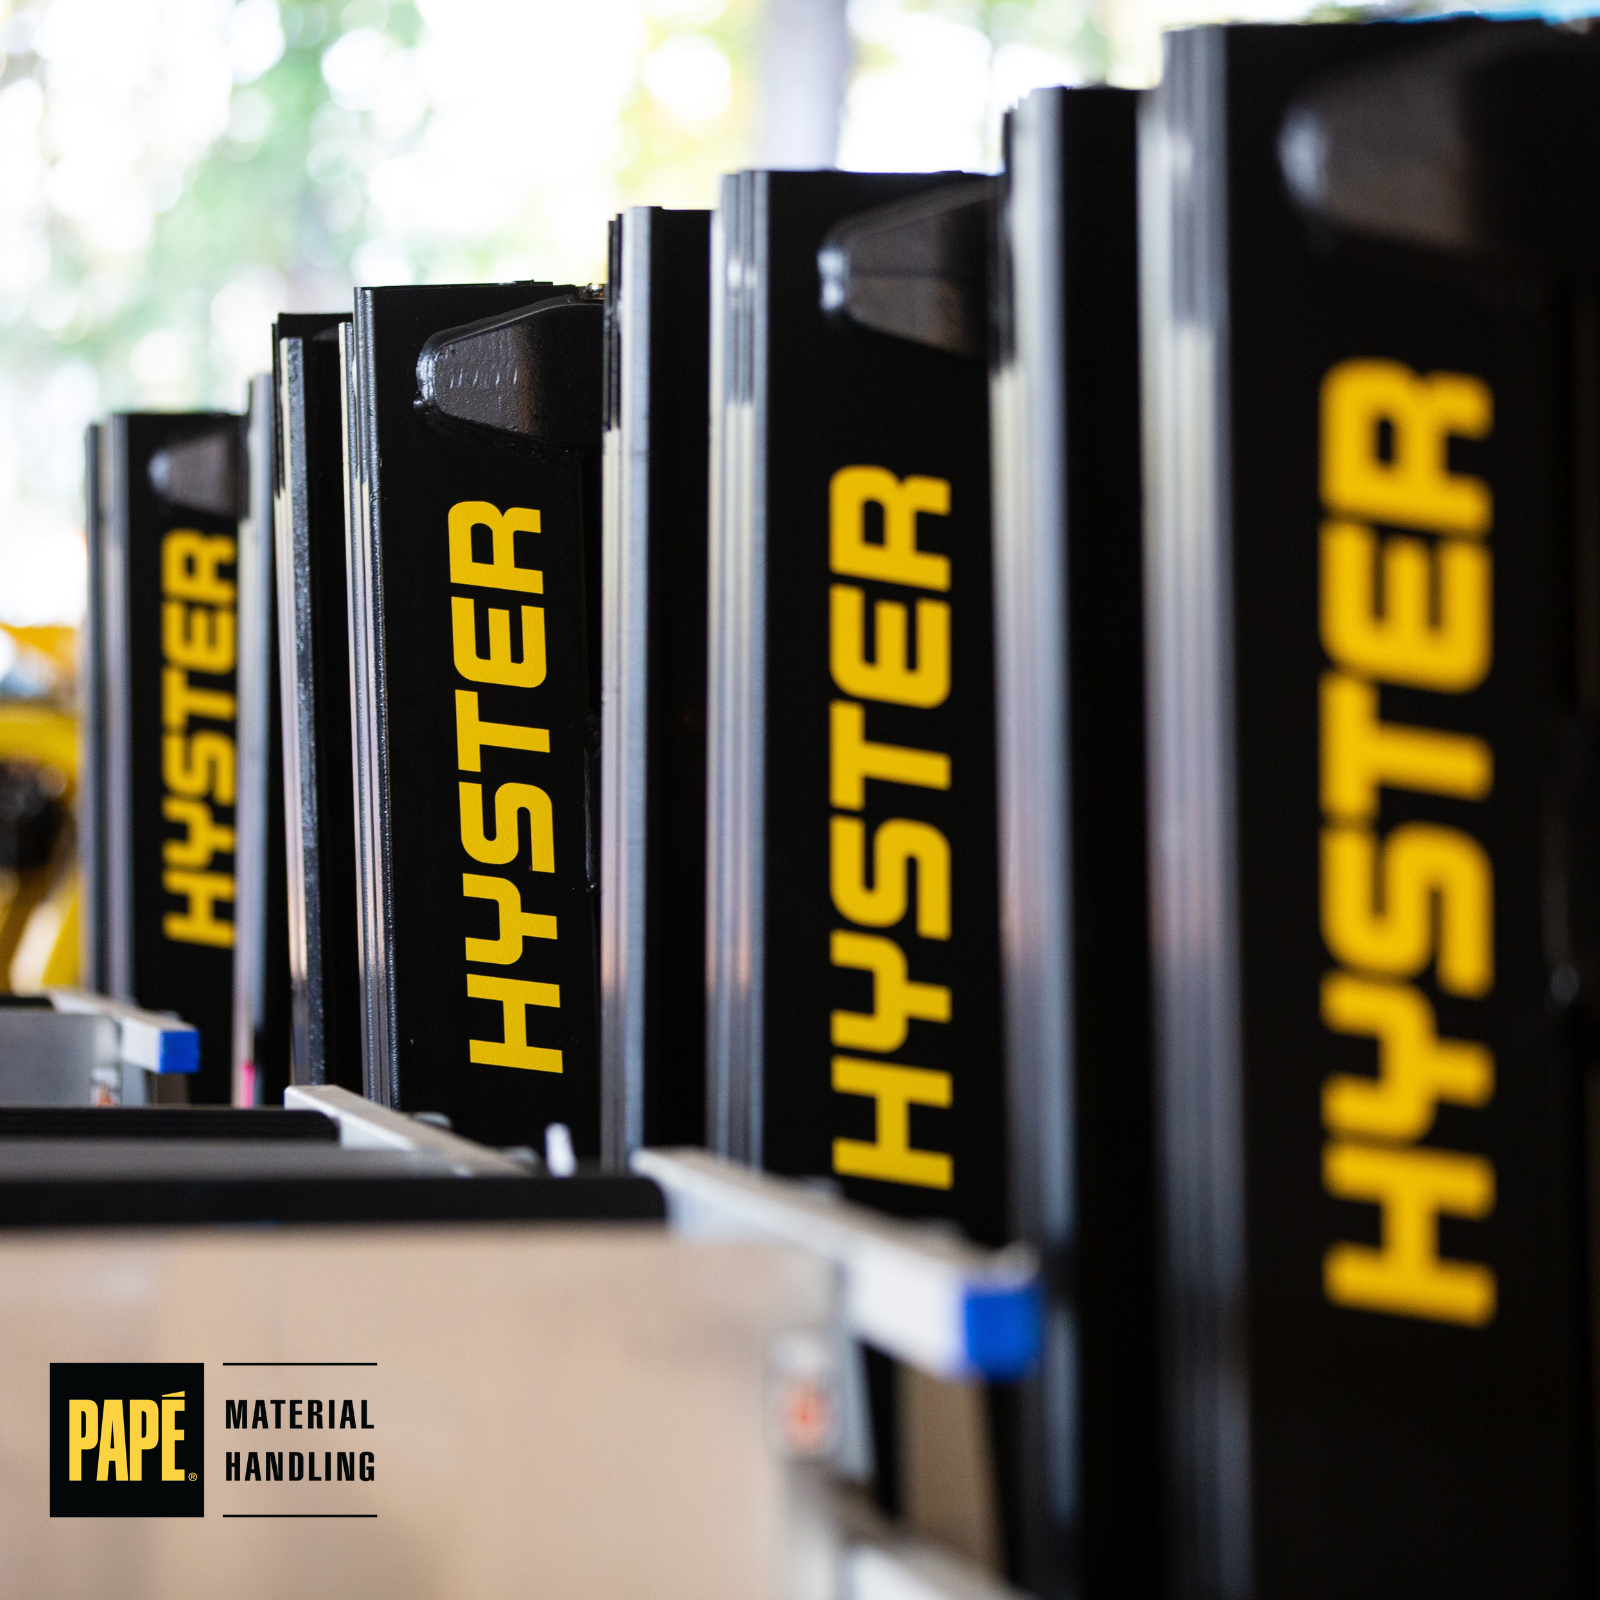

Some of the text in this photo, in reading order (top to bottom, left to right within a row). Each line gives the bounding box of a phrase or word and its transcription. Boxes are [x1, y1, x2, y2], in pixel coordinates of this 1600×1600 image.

[162, 528, 238, 948] HYSTER
[447, 499, 563, 1074] HYSTER
[829, 465, 952, 1189] HYSTER
[1319, 358, 1496, 1325] HYSTER
